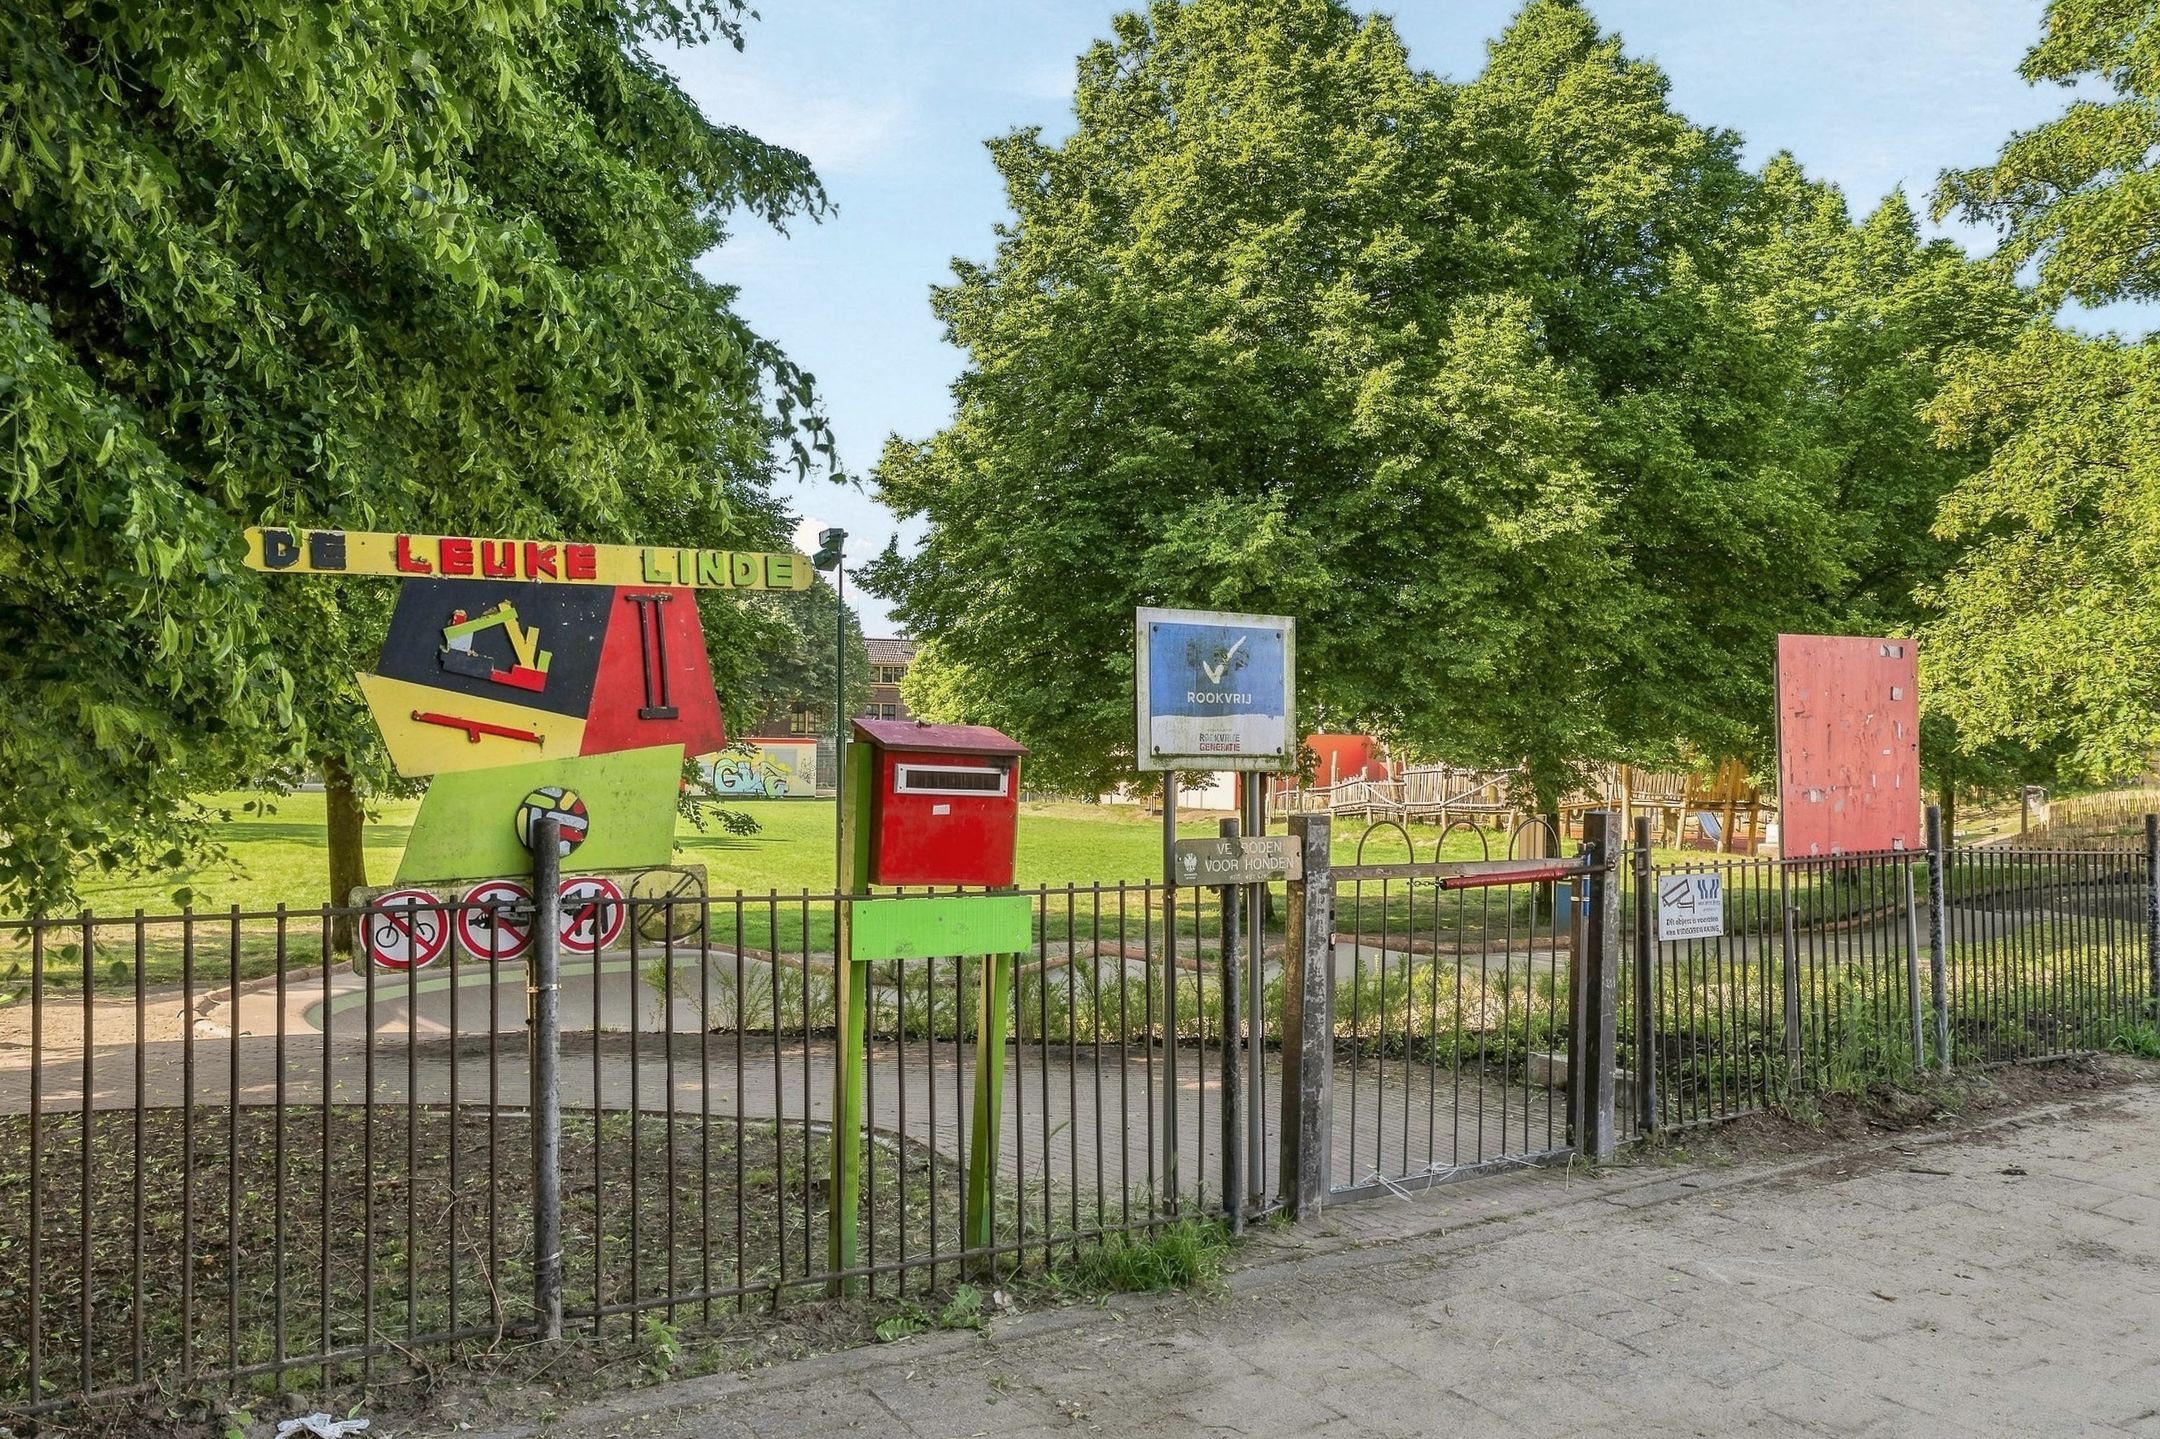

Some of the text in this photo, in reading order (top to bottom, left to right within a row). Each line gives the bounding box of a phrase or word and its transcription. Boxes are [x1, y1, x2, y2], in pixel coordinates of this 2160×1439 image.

[265, 529, 794, 588] DE LEUKE LINDE
[1187, 692, 1252, 705] ROOKVRIJ
[1199, 743, 1240, 752] GENERATIE
[1216, 842, 1282, 855] VEBODEN
[1205, 857, 1294, 872] VOOR HONDEN
